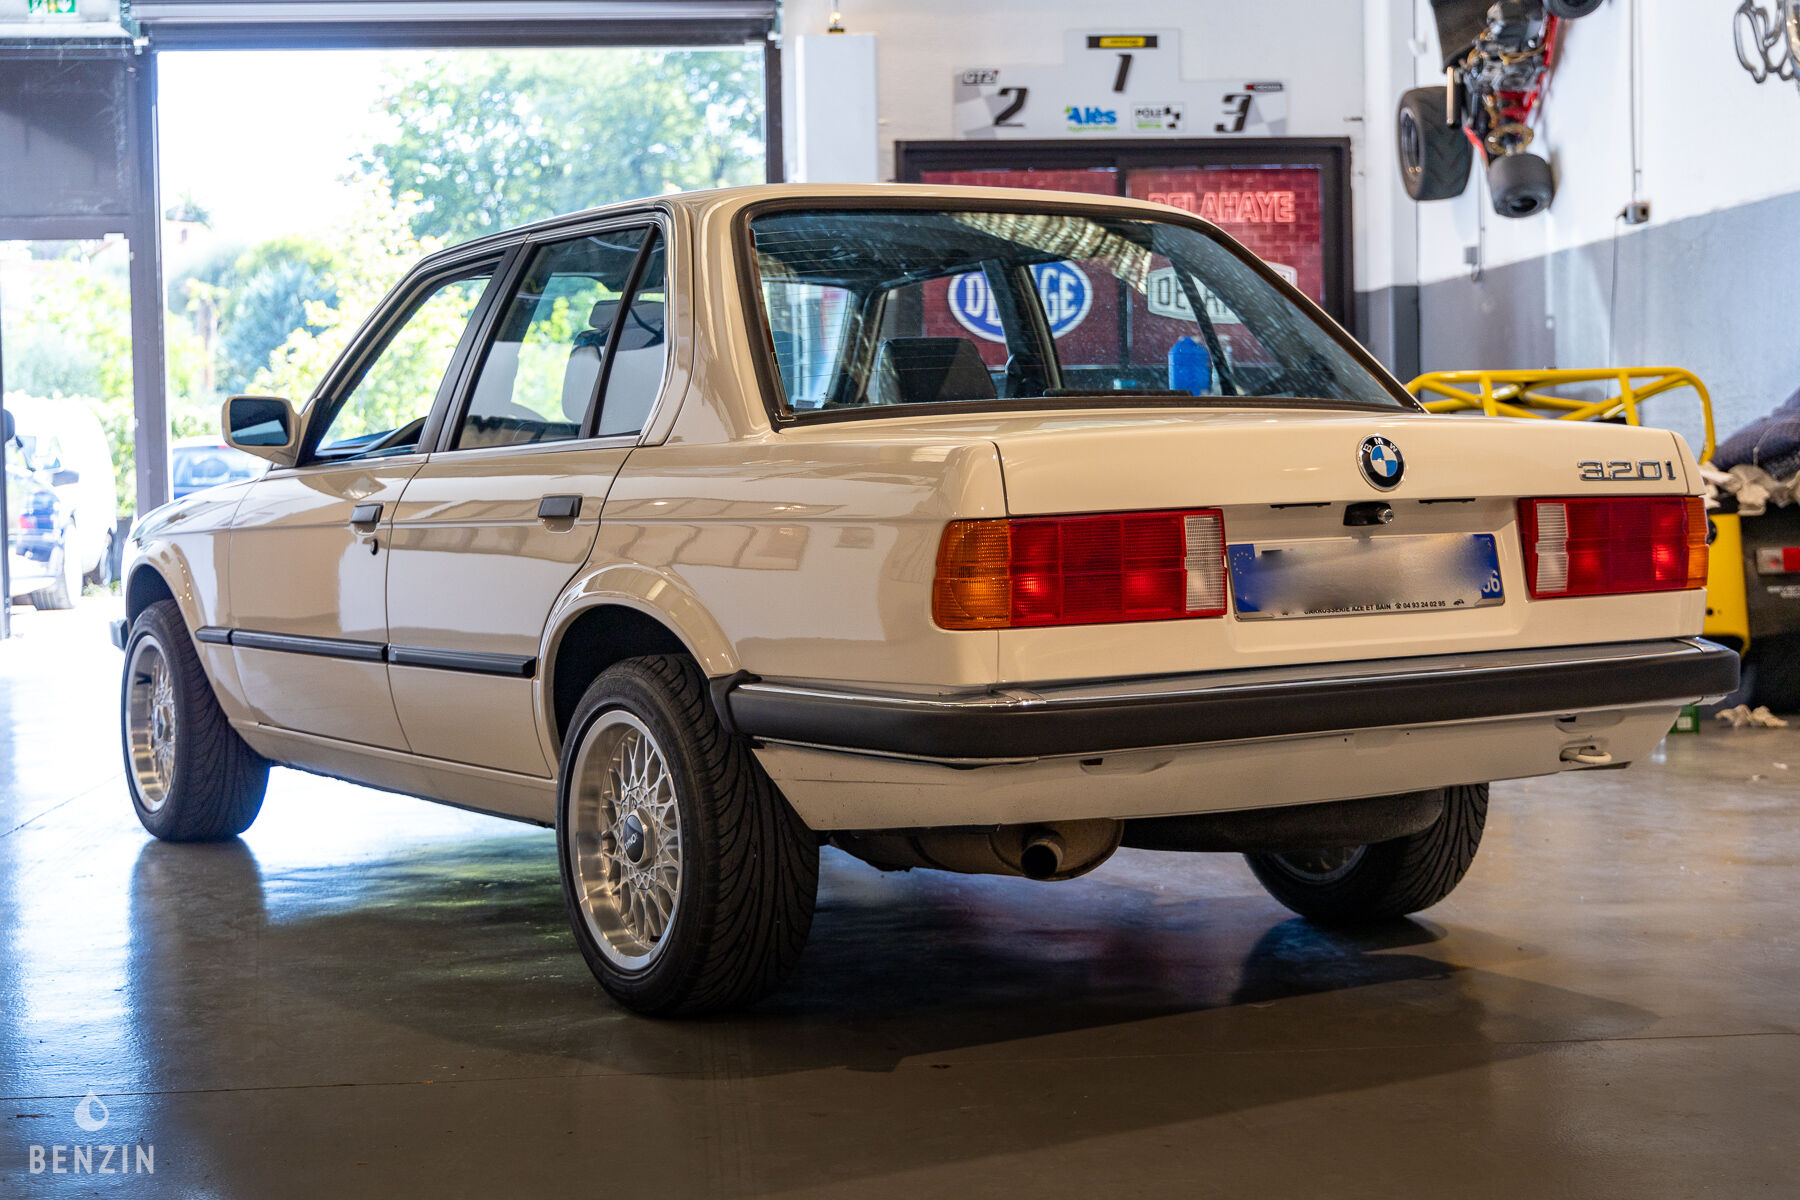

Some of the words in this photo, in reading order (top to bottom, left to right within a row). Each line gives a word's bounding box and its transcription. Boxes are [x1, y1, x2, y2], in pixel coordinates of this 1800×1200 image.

[1114, 54, 1133, 92] 1
[994, 87, 1028, 127] 2
[1215, 94, 1252, 133] 3
[1362, 436, 1399, 453] BMW
